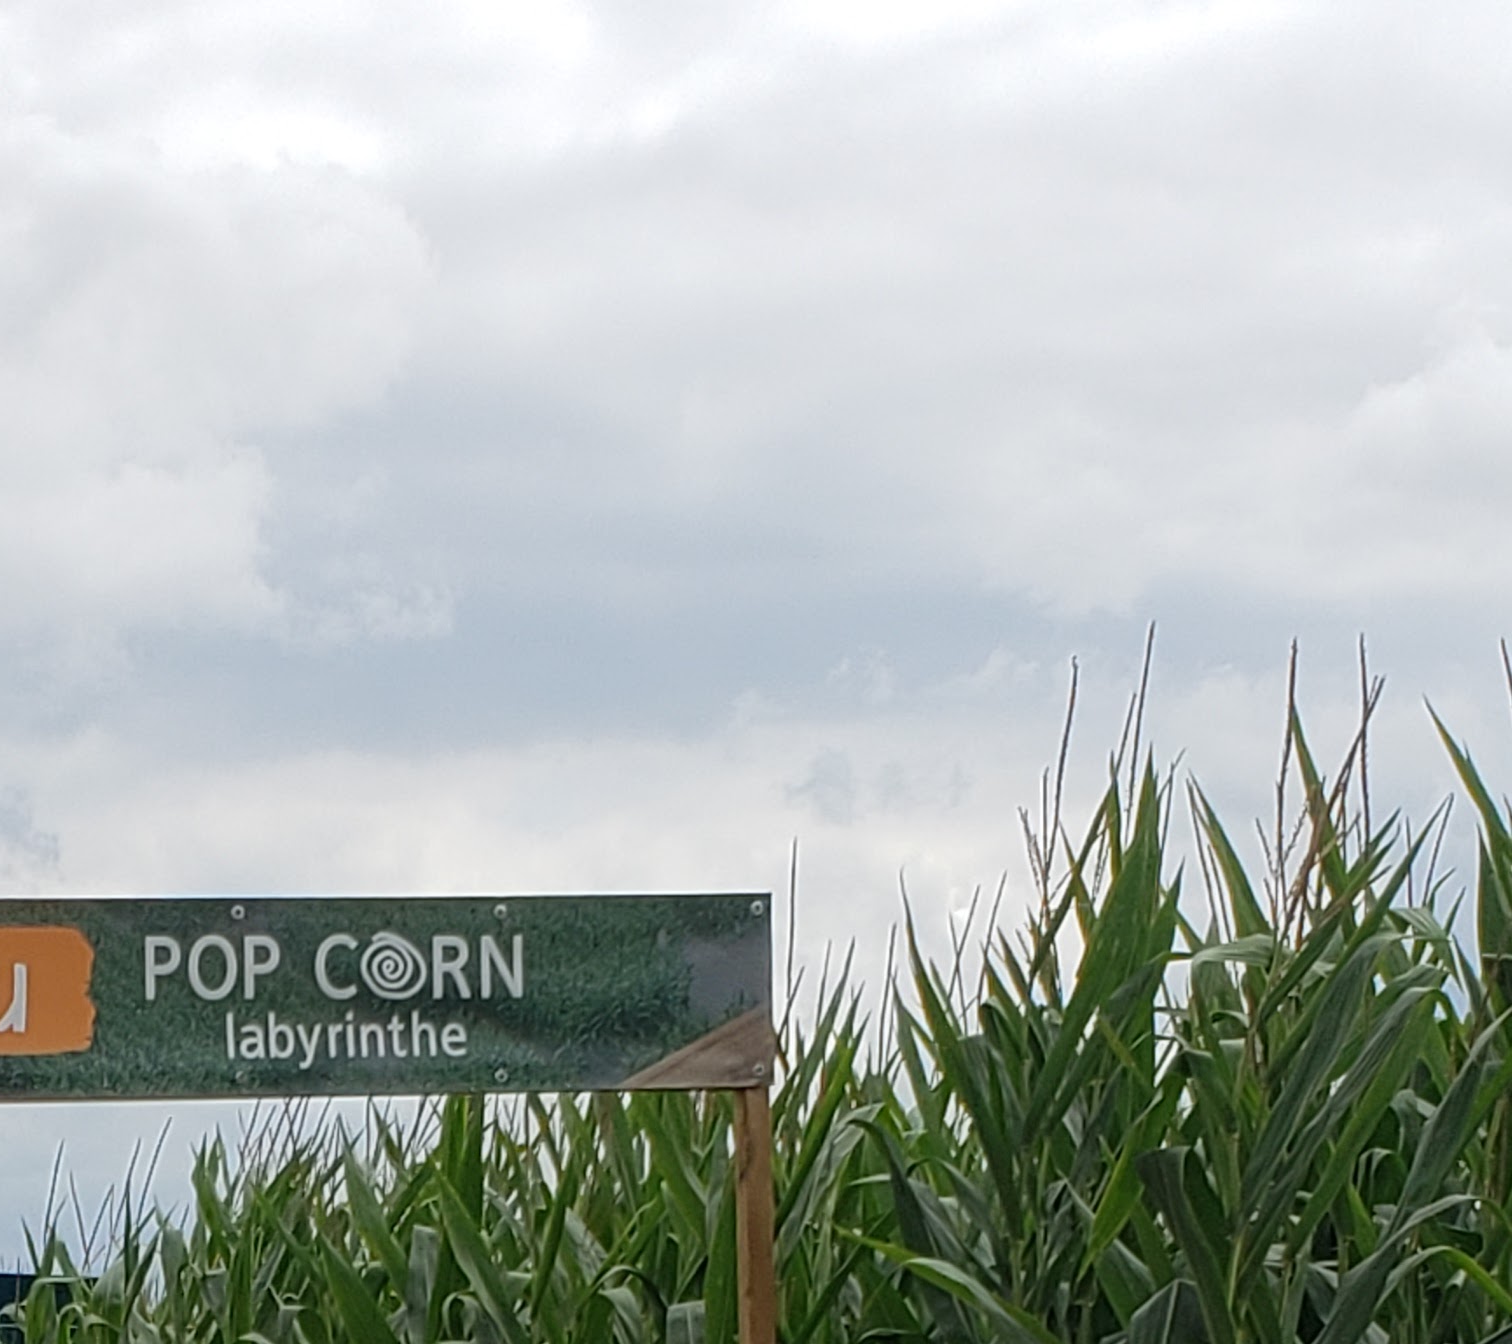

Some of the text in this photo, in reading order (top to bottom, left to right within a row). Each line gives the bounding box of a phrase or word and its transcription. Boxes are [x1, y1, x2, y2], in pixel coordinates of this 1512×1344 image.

[143, 930, 525, 1001] POP CORN
[225, 1010, 468, 1070] labyrinthe
